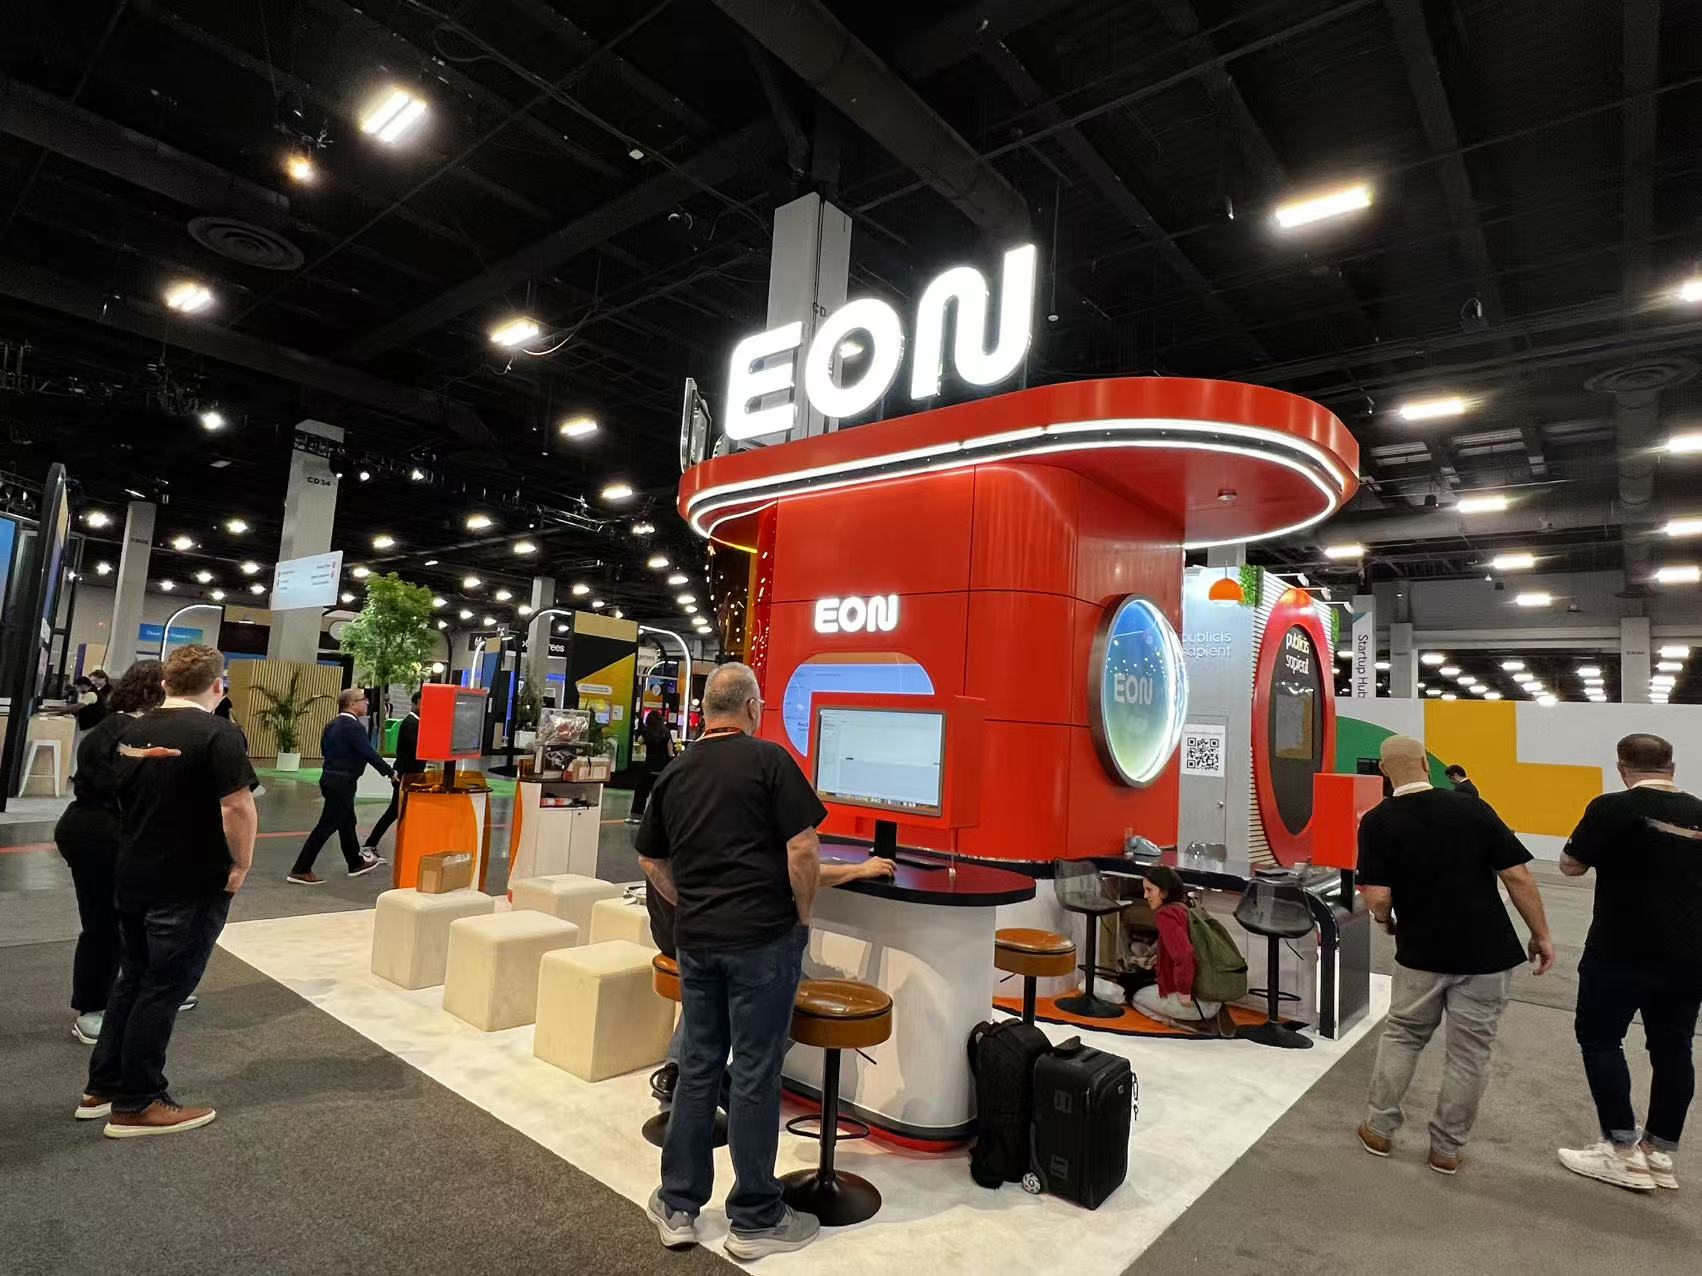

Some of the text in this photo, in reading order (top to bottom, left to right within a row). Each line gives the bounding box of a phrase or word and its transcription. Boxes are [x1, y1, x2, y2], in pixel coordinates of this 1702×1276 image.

[725, 243, 1037, 440] EON
[307, 477, 331, 486] CD34
[815, 594, 899, 633] EON
[1286, 632, 1310, 655] publicis
[1355, 634, 1369, 698] Startup Hub
[1113, 673, 1153, 705] EON
